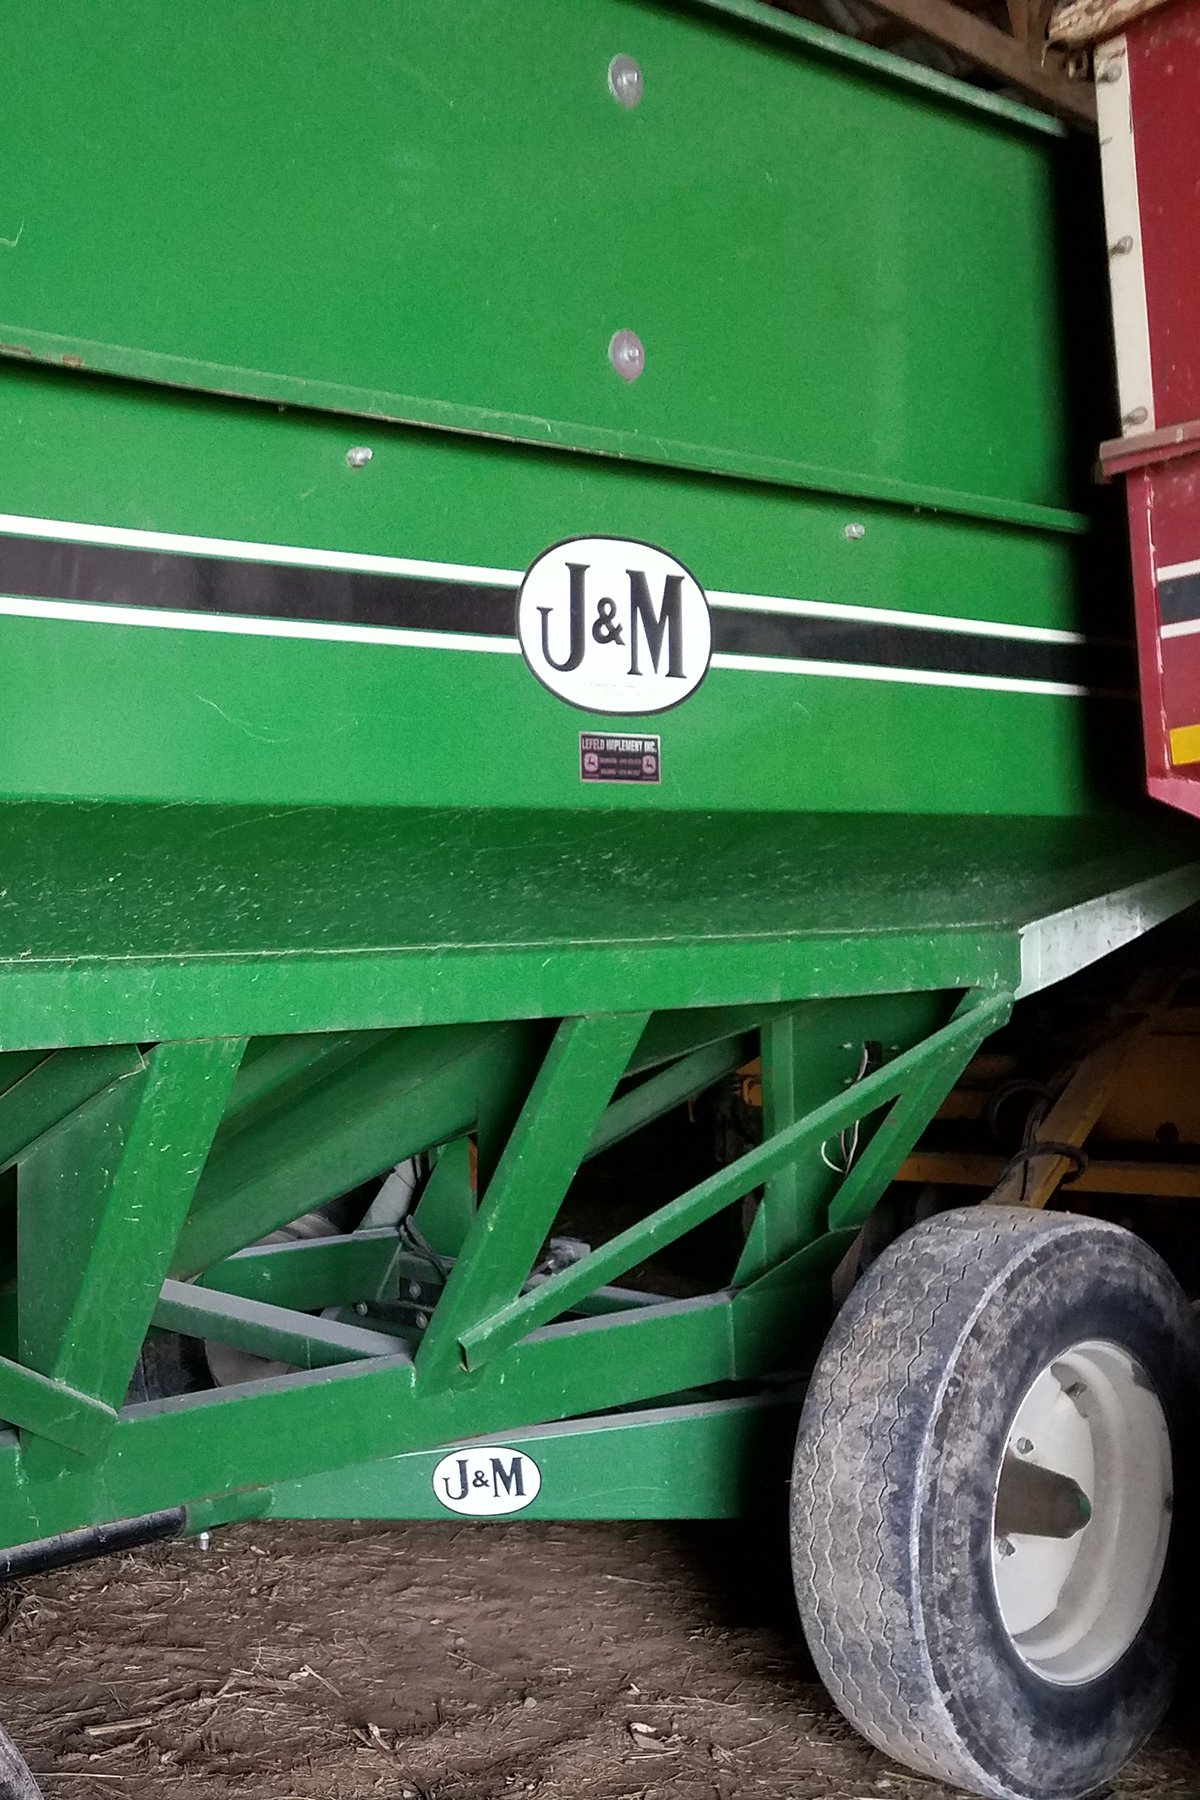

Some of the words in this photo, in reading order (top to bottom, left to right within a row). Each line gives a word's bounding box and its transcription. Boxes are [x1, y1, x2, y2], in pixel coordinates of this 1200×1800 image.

[536, 562, 687, 679] J&M
[606, 739, 643, 752] IMPLEMENT
[442, 1456, 527, 1501] J&M
